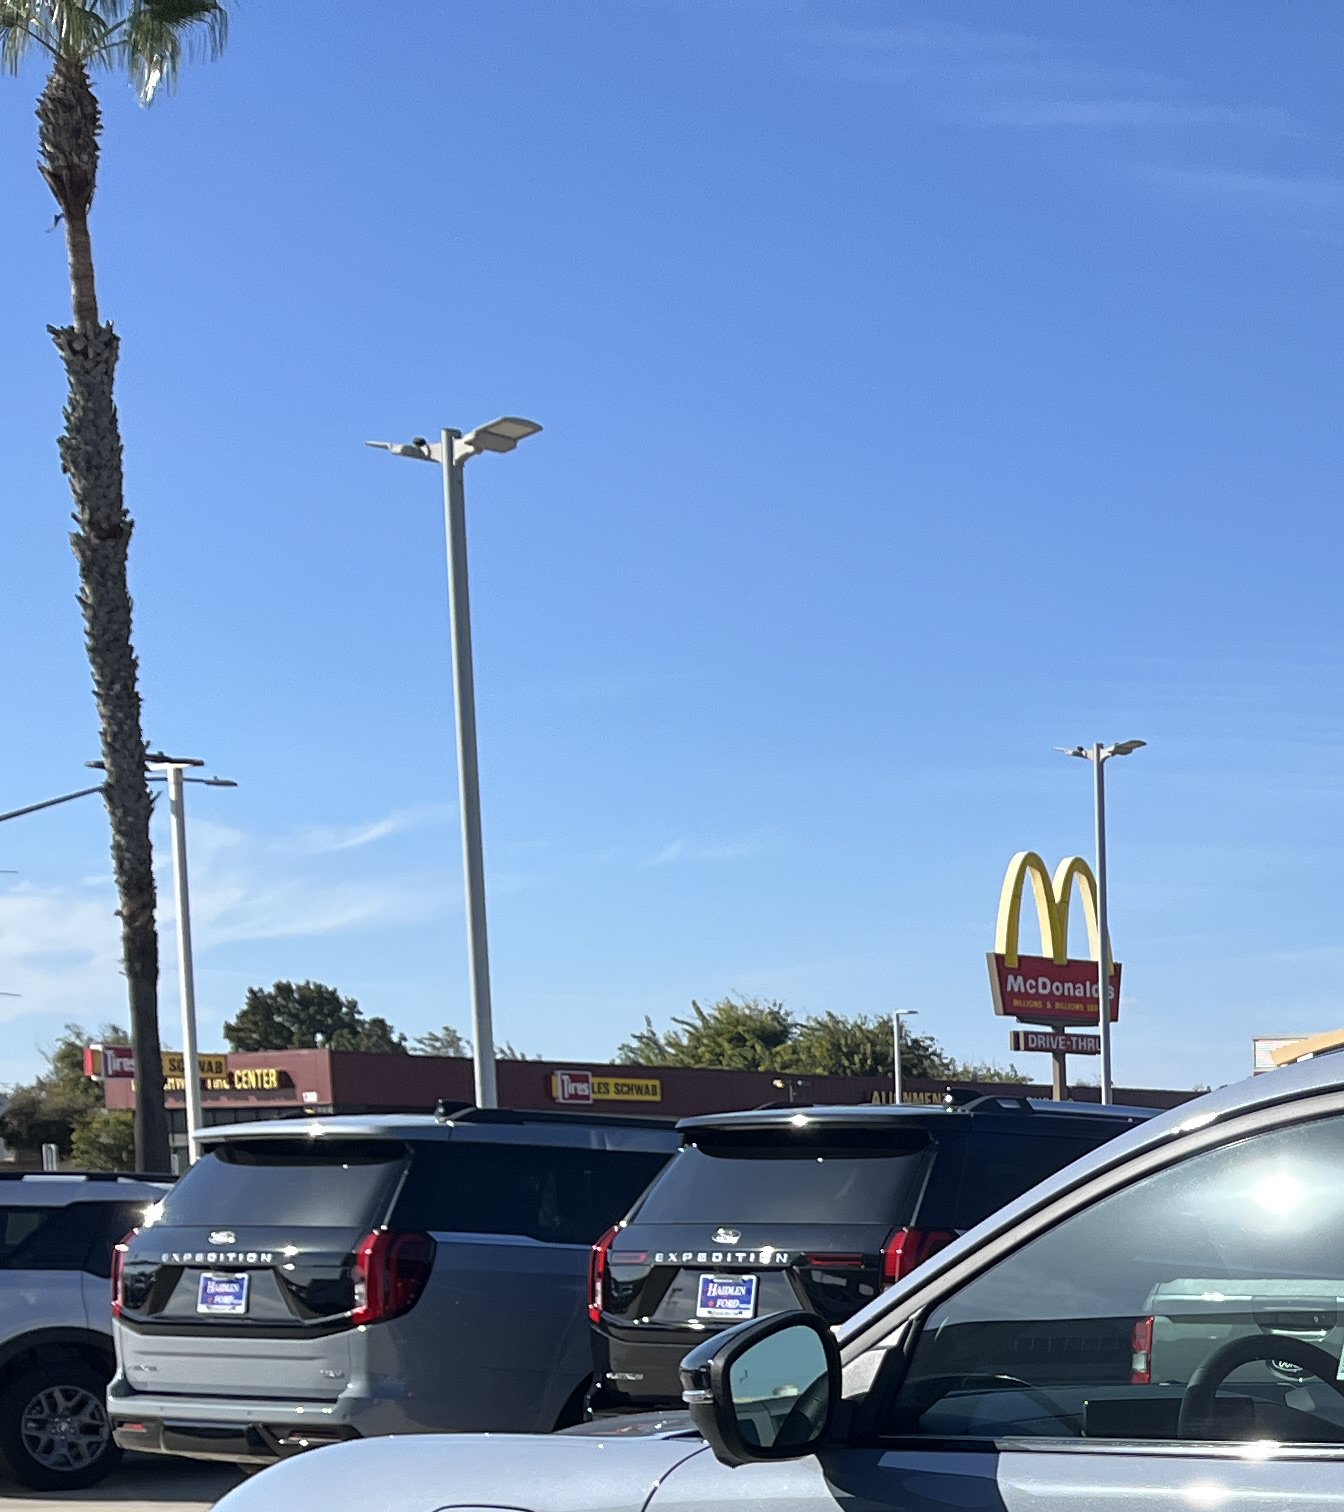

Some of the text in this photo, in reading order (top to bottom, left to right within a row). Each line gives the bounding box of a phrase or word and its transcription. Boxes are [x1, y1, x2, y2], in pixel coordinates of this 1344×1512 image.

[234, 1068, 279, 1090] CENTER
[561, 1074, 589, 1099] Tires
[592, 1081, 658, 1096] LES SCHWAB
[161, 1252, 273, 1264] EXPEDITION
[654, 1252, 788, 1264] EXPEDITION
[707, 1283, 747, 1297] HAIDLEN
[716, 1299, 740, 1309] FORD
